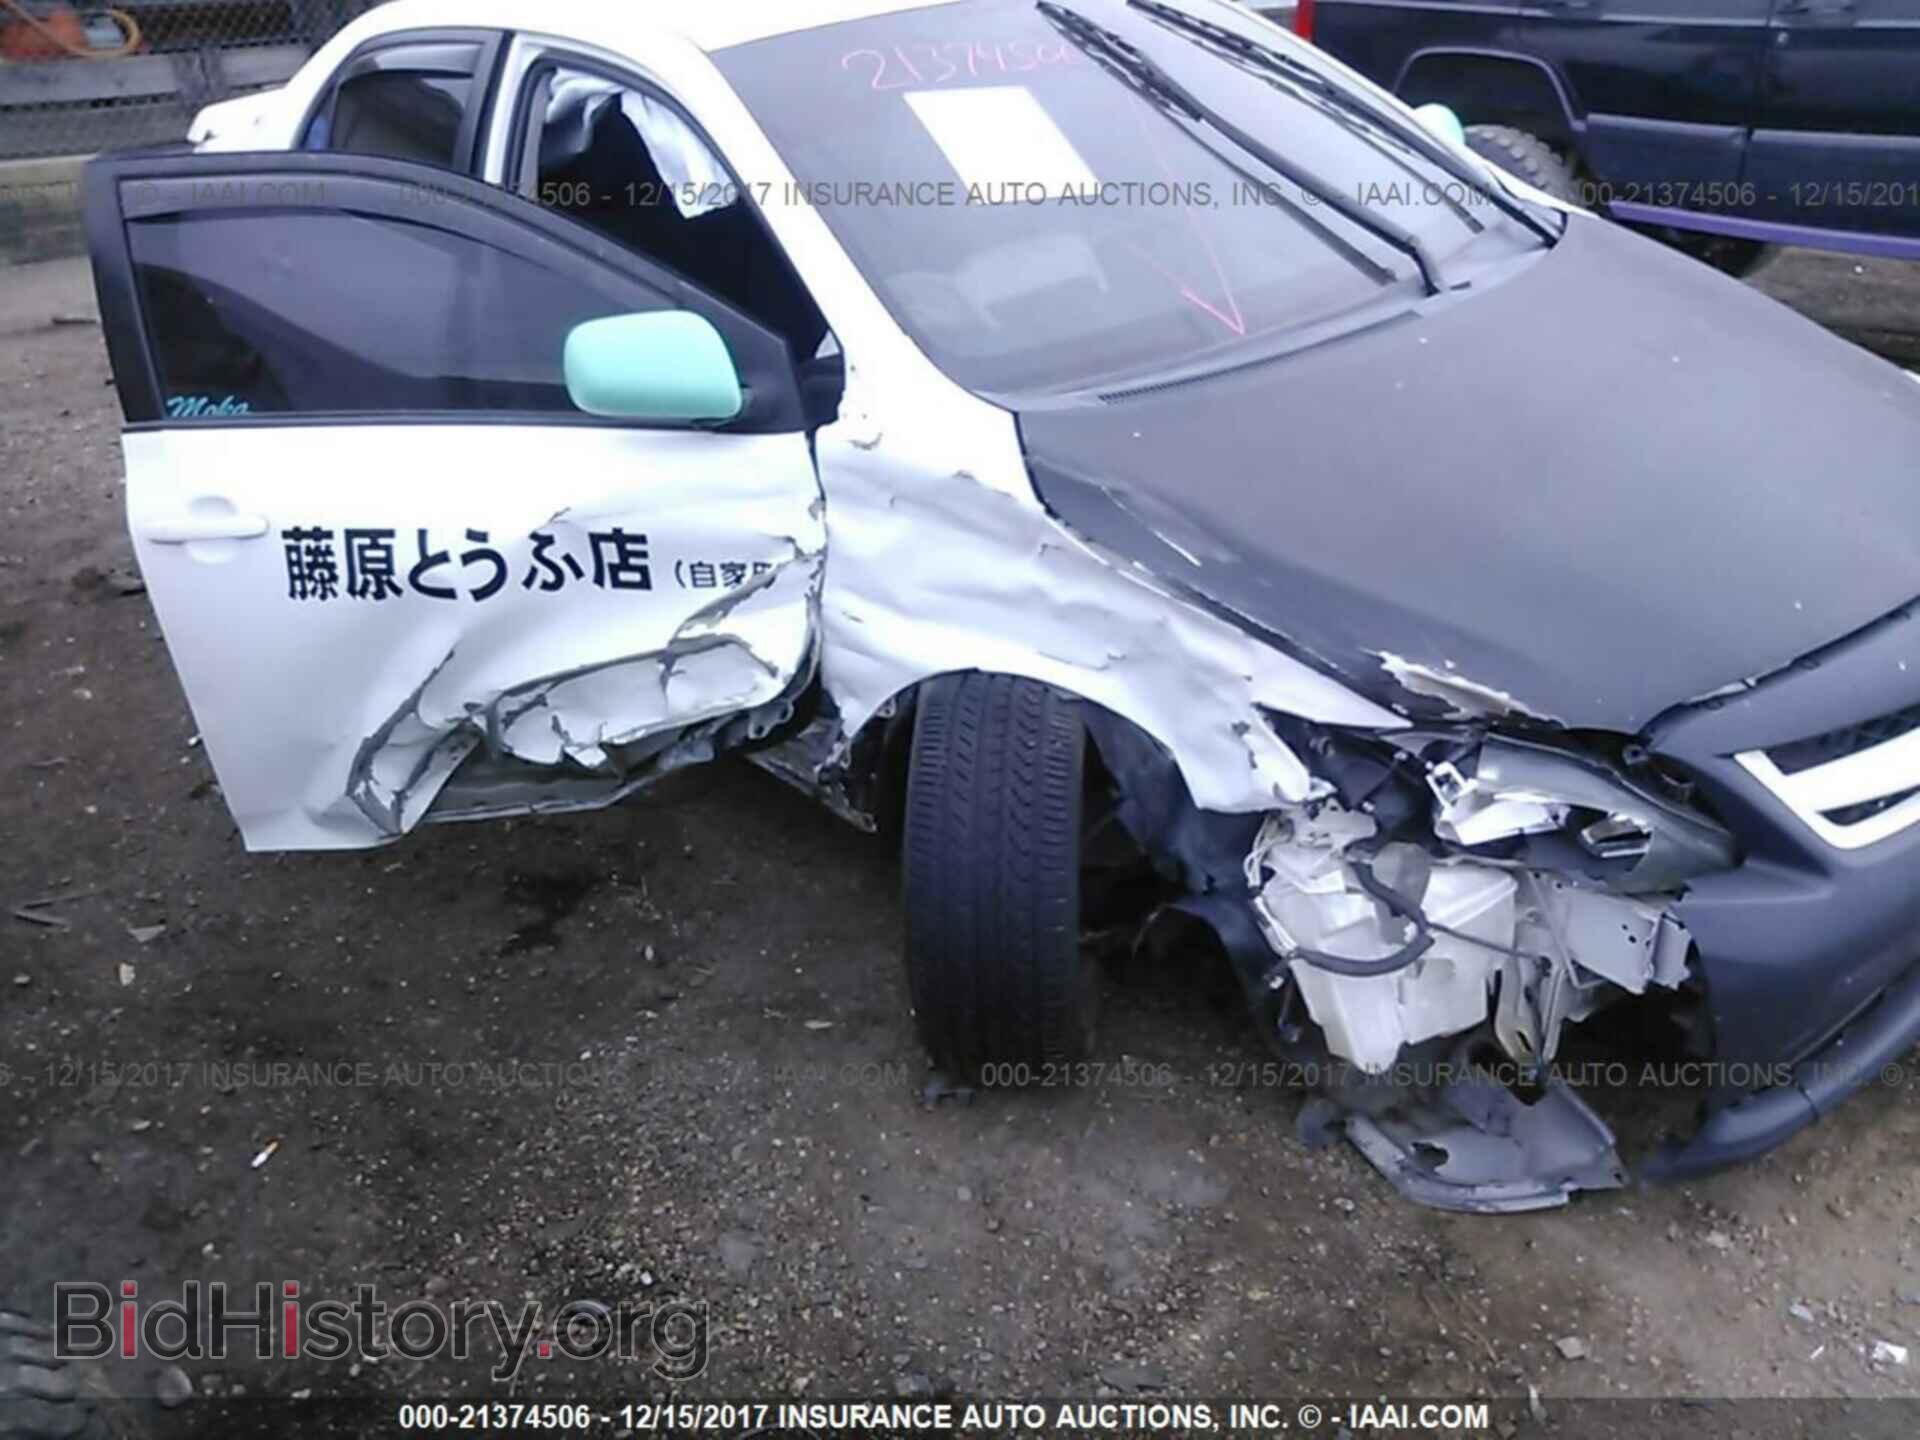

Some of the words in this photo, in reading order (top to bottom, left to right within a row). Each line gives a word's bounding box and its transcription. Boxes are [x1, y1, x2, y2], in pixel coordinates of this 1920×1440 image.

[281, 526, 653, 602] 藤原とうふ店
